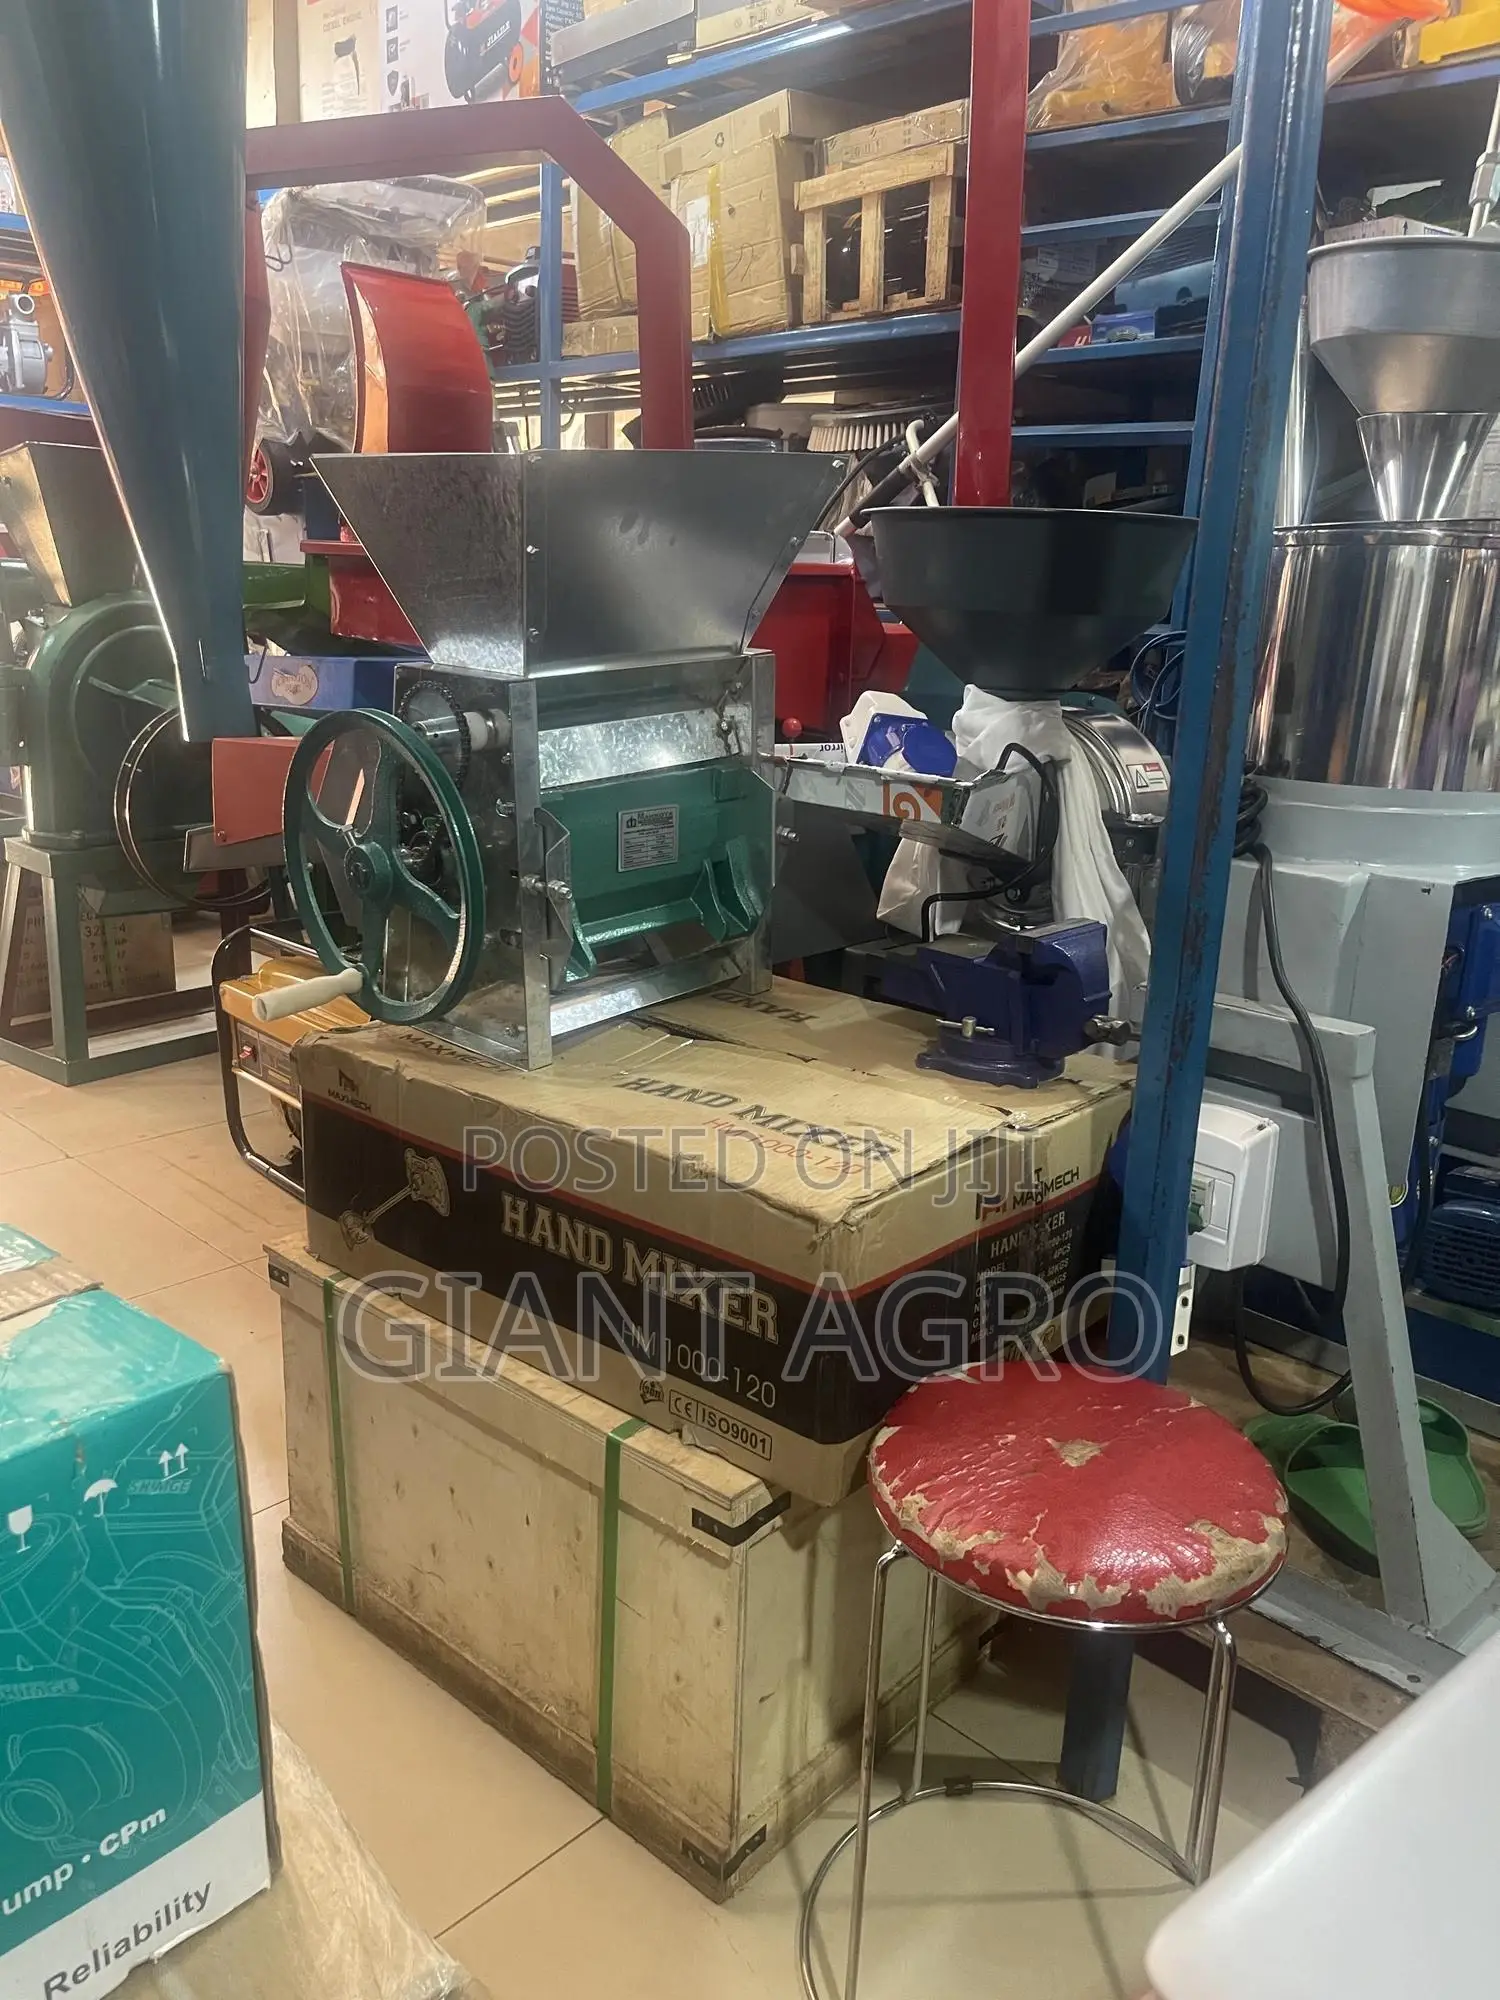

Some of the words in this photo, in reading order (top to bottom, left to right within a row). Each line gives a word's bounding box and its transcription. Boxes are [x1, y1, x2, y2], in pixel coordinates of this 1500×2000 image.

[819, 744, 844, 753] irror
[612, 1076, 745, 1108] HAND
[729, 1103, 900, 1160] MIXER
[502, 1192, 613, 1275] HAND
[622, 1238, 780, 1345] MIXER
[701, 1409, 768, 1455] ISO9001
[1, 1861, 74, 1917] ump
[43, 1880, 212, 2000] Reliability
